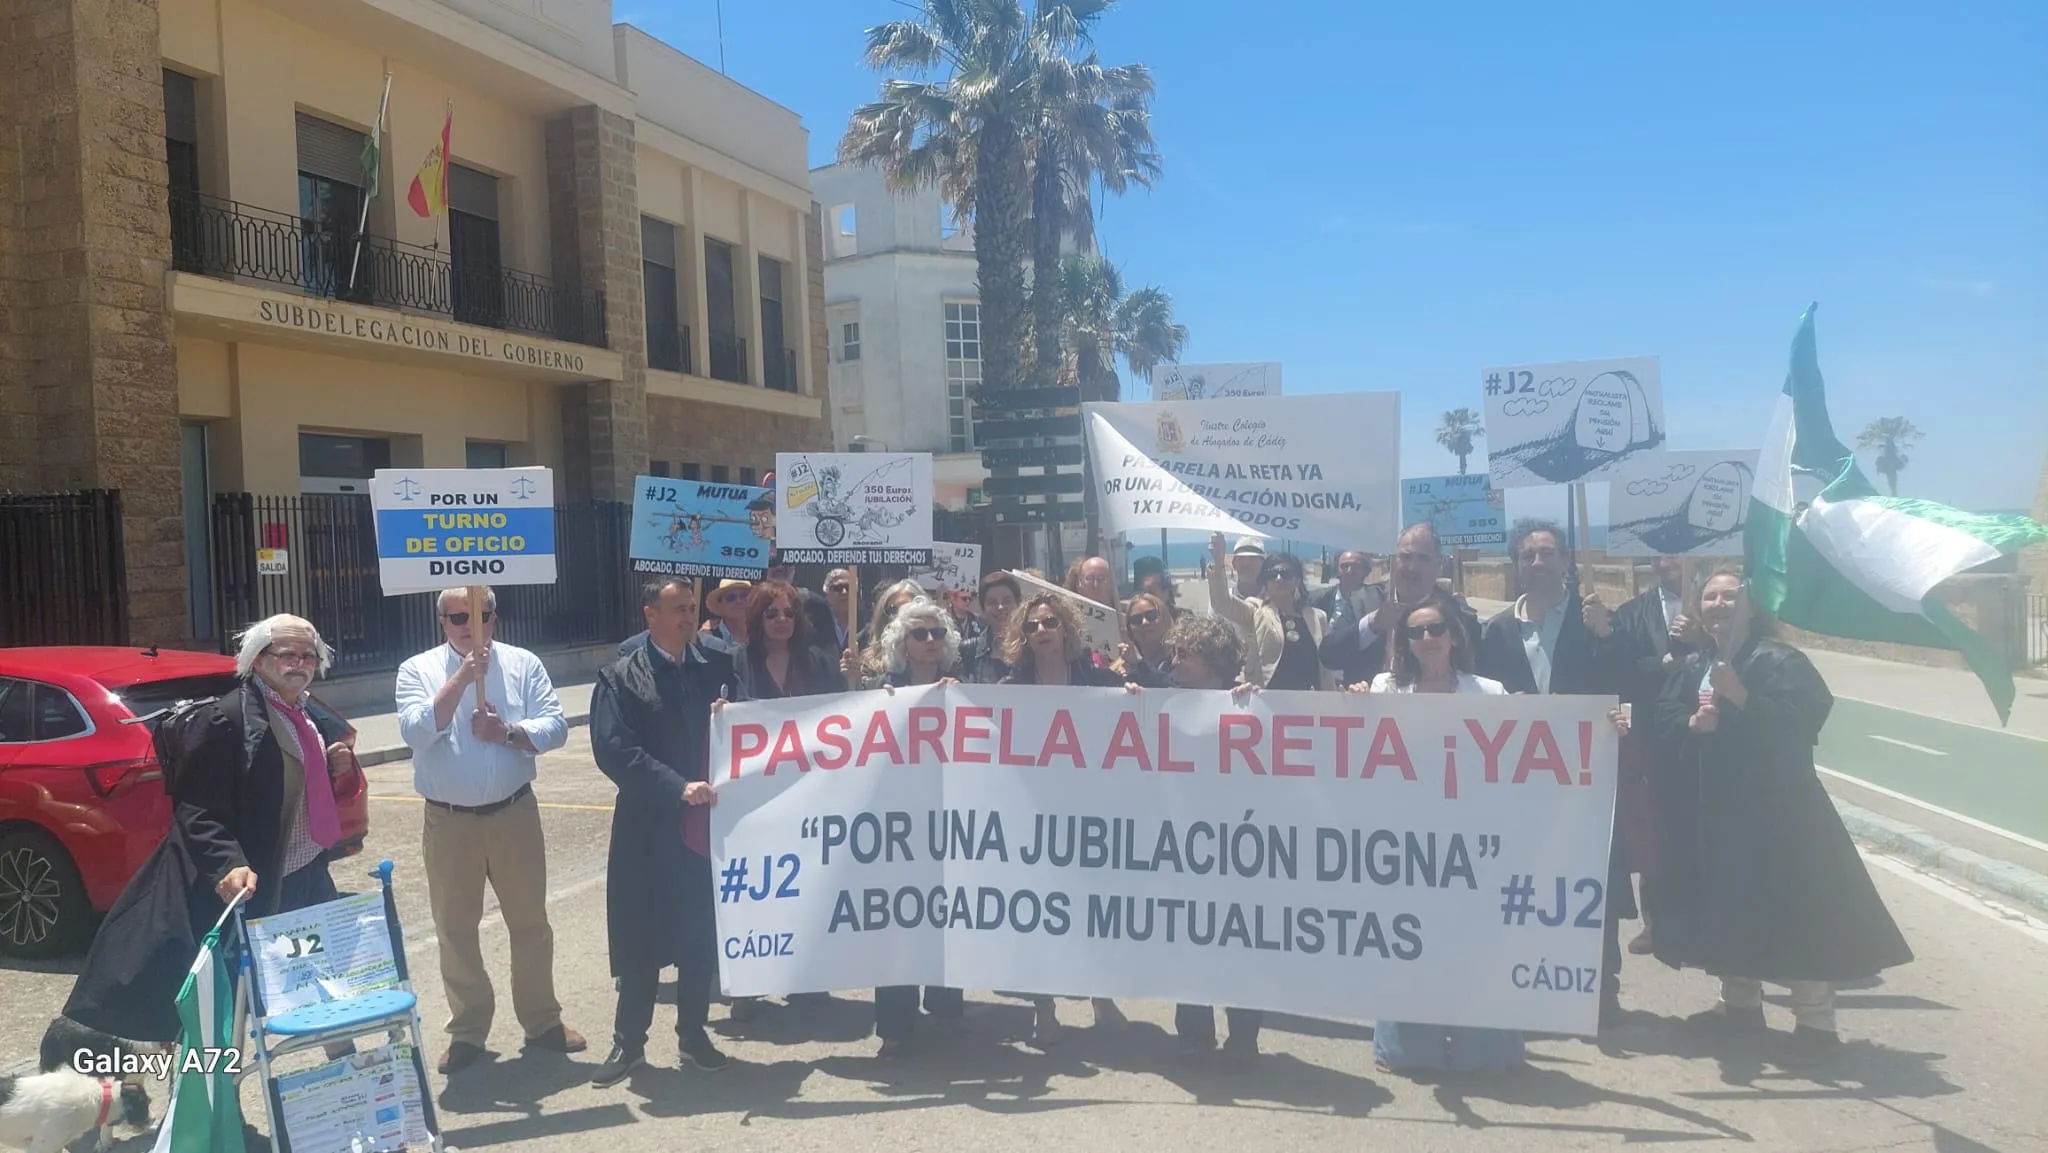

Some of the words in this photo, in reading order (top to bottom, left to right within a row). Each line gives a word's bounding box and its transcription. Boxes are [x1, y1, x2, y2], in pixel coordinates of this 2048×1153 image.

[260, 300, 449, 350] SUBDELEGACION
[458, 335, 493, 357] DEL
[503, 343, 584, 372] GOBIERNO
[1486, 370, 1535, 396] #J2
[1232, 418, 1267, 433] Colegio
[1190, 436, 1199, 446] de
[1243, 435, 1255, 447] de
[1257, 433, 1287, 449] Cádiz
[1122, 455, 1220, 480] PASARELA
[1224, 463, 1248, 480] AL
[1250, 463, 1293, 481] RETA
[1296, 463, 1324, 481] YA
[645, 486, 677, 502] #J2
[697, 484, 749, 500] MUTUA
[864, 485, 884, 494] 350
[1103, 478, 1121, 496] OR
[1124, 476, 1163, 492] UNA
[1167, 479, 1288, 508] JUBILACIÓN
[1291, 492, 1363, 512] DIGNA,
[1409, 483, 1432, 495] #J2
[430, 493, 467, 506] POR
[473, 493, 499, 505] UN
[864, 494, 913, 503] JUBILACIÓN
[423, 512, 507, 529] TURNO
[1132, 500, 1163, 515] 1X1
[1167, 500, 1222, 519] PARA
[1228, 508, 1301, 531] TODOS
[406, 537, 438, 553] DE
[445, 535, 526, 552] OFICIO
[720, 545, 760, 558] 350
[782, 550, 826, 565] ABOGADO,
[827, 551, 869, 564] DEFIENDE
[869, 551, 882, 564] TUS
[884, 551, 926, 564] DERECHOS
[954, 548, 975, 558] #J2
[259, 562, 288, 572] SALIDA
[429, 559, 505, 576] DIGNO
[634, 559, 674, 575] ABOGADO,
[675, 563, 711, 577] DEFIENDE
[712, 566, 725, 578] TUS
[725, 566, 762, 580] DERECHOS
[729, 706, 1088, 780] PASARELA
[1101, 710, 1196, 774] AL
[1218, 713, 1418, 782] RETA
[1443, 718, 1594, 800] ¡YA!
[800, 810, 915, 866] “POR
[928, 808, 1009, 863] UNA
[1019, 808, 1298, 881] JUBILACIÓN
[1316, 826, 1501, 891] DIGNA”
[720, 852, 802, 904] #J2
[1500, 874, 1604, 929] #J2
[828, 884, 1072, 937] ABOGADOS
[1087, 893, 1424, 962] MUTUALISTAS
[724, 928, 795, 960] CÁDIZ
[1511, 957, 1598, 994] CÁDIZ
